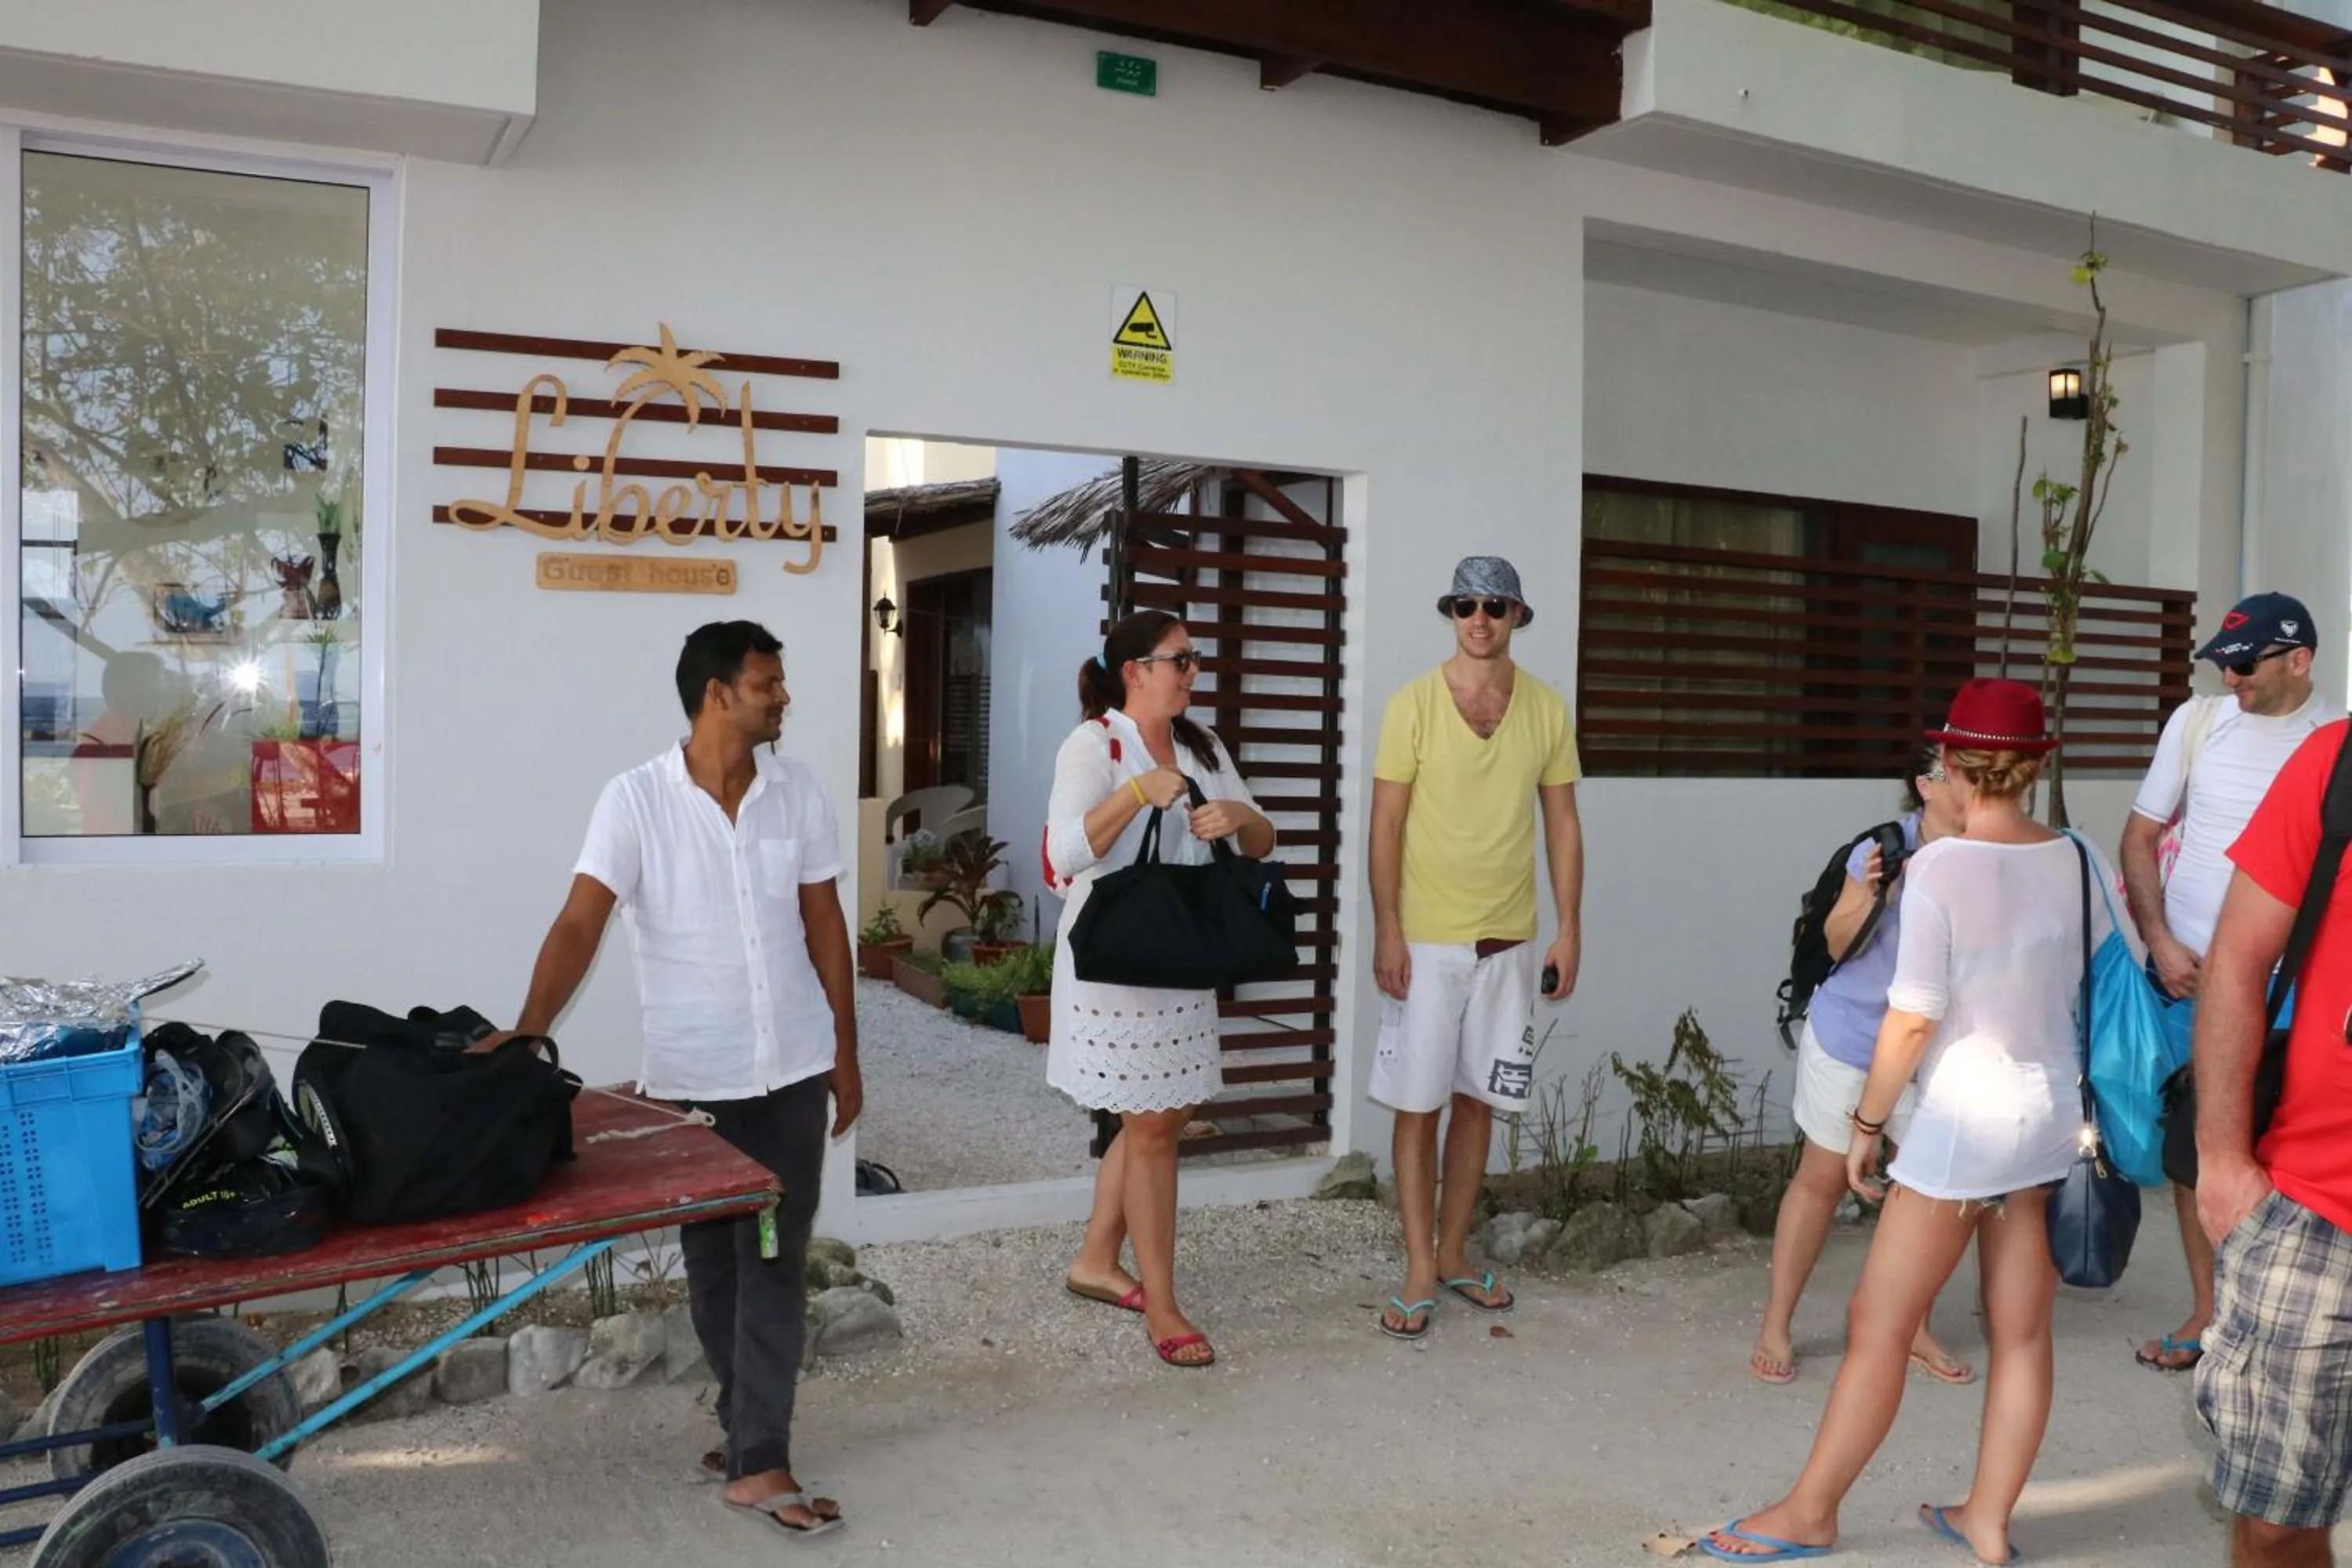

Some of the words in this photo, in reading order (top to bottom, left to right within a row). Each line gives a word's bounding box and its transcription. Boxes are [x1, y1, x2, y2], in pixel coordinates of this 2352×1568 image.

[1117, 348, 1167, 365] WARNING
[448, 374, 823, 574] Liberty
[543, 557, 633, 583] Guest
[649, 561, 730, 586] house
[183, 1191, 217, 1209] ADULT
